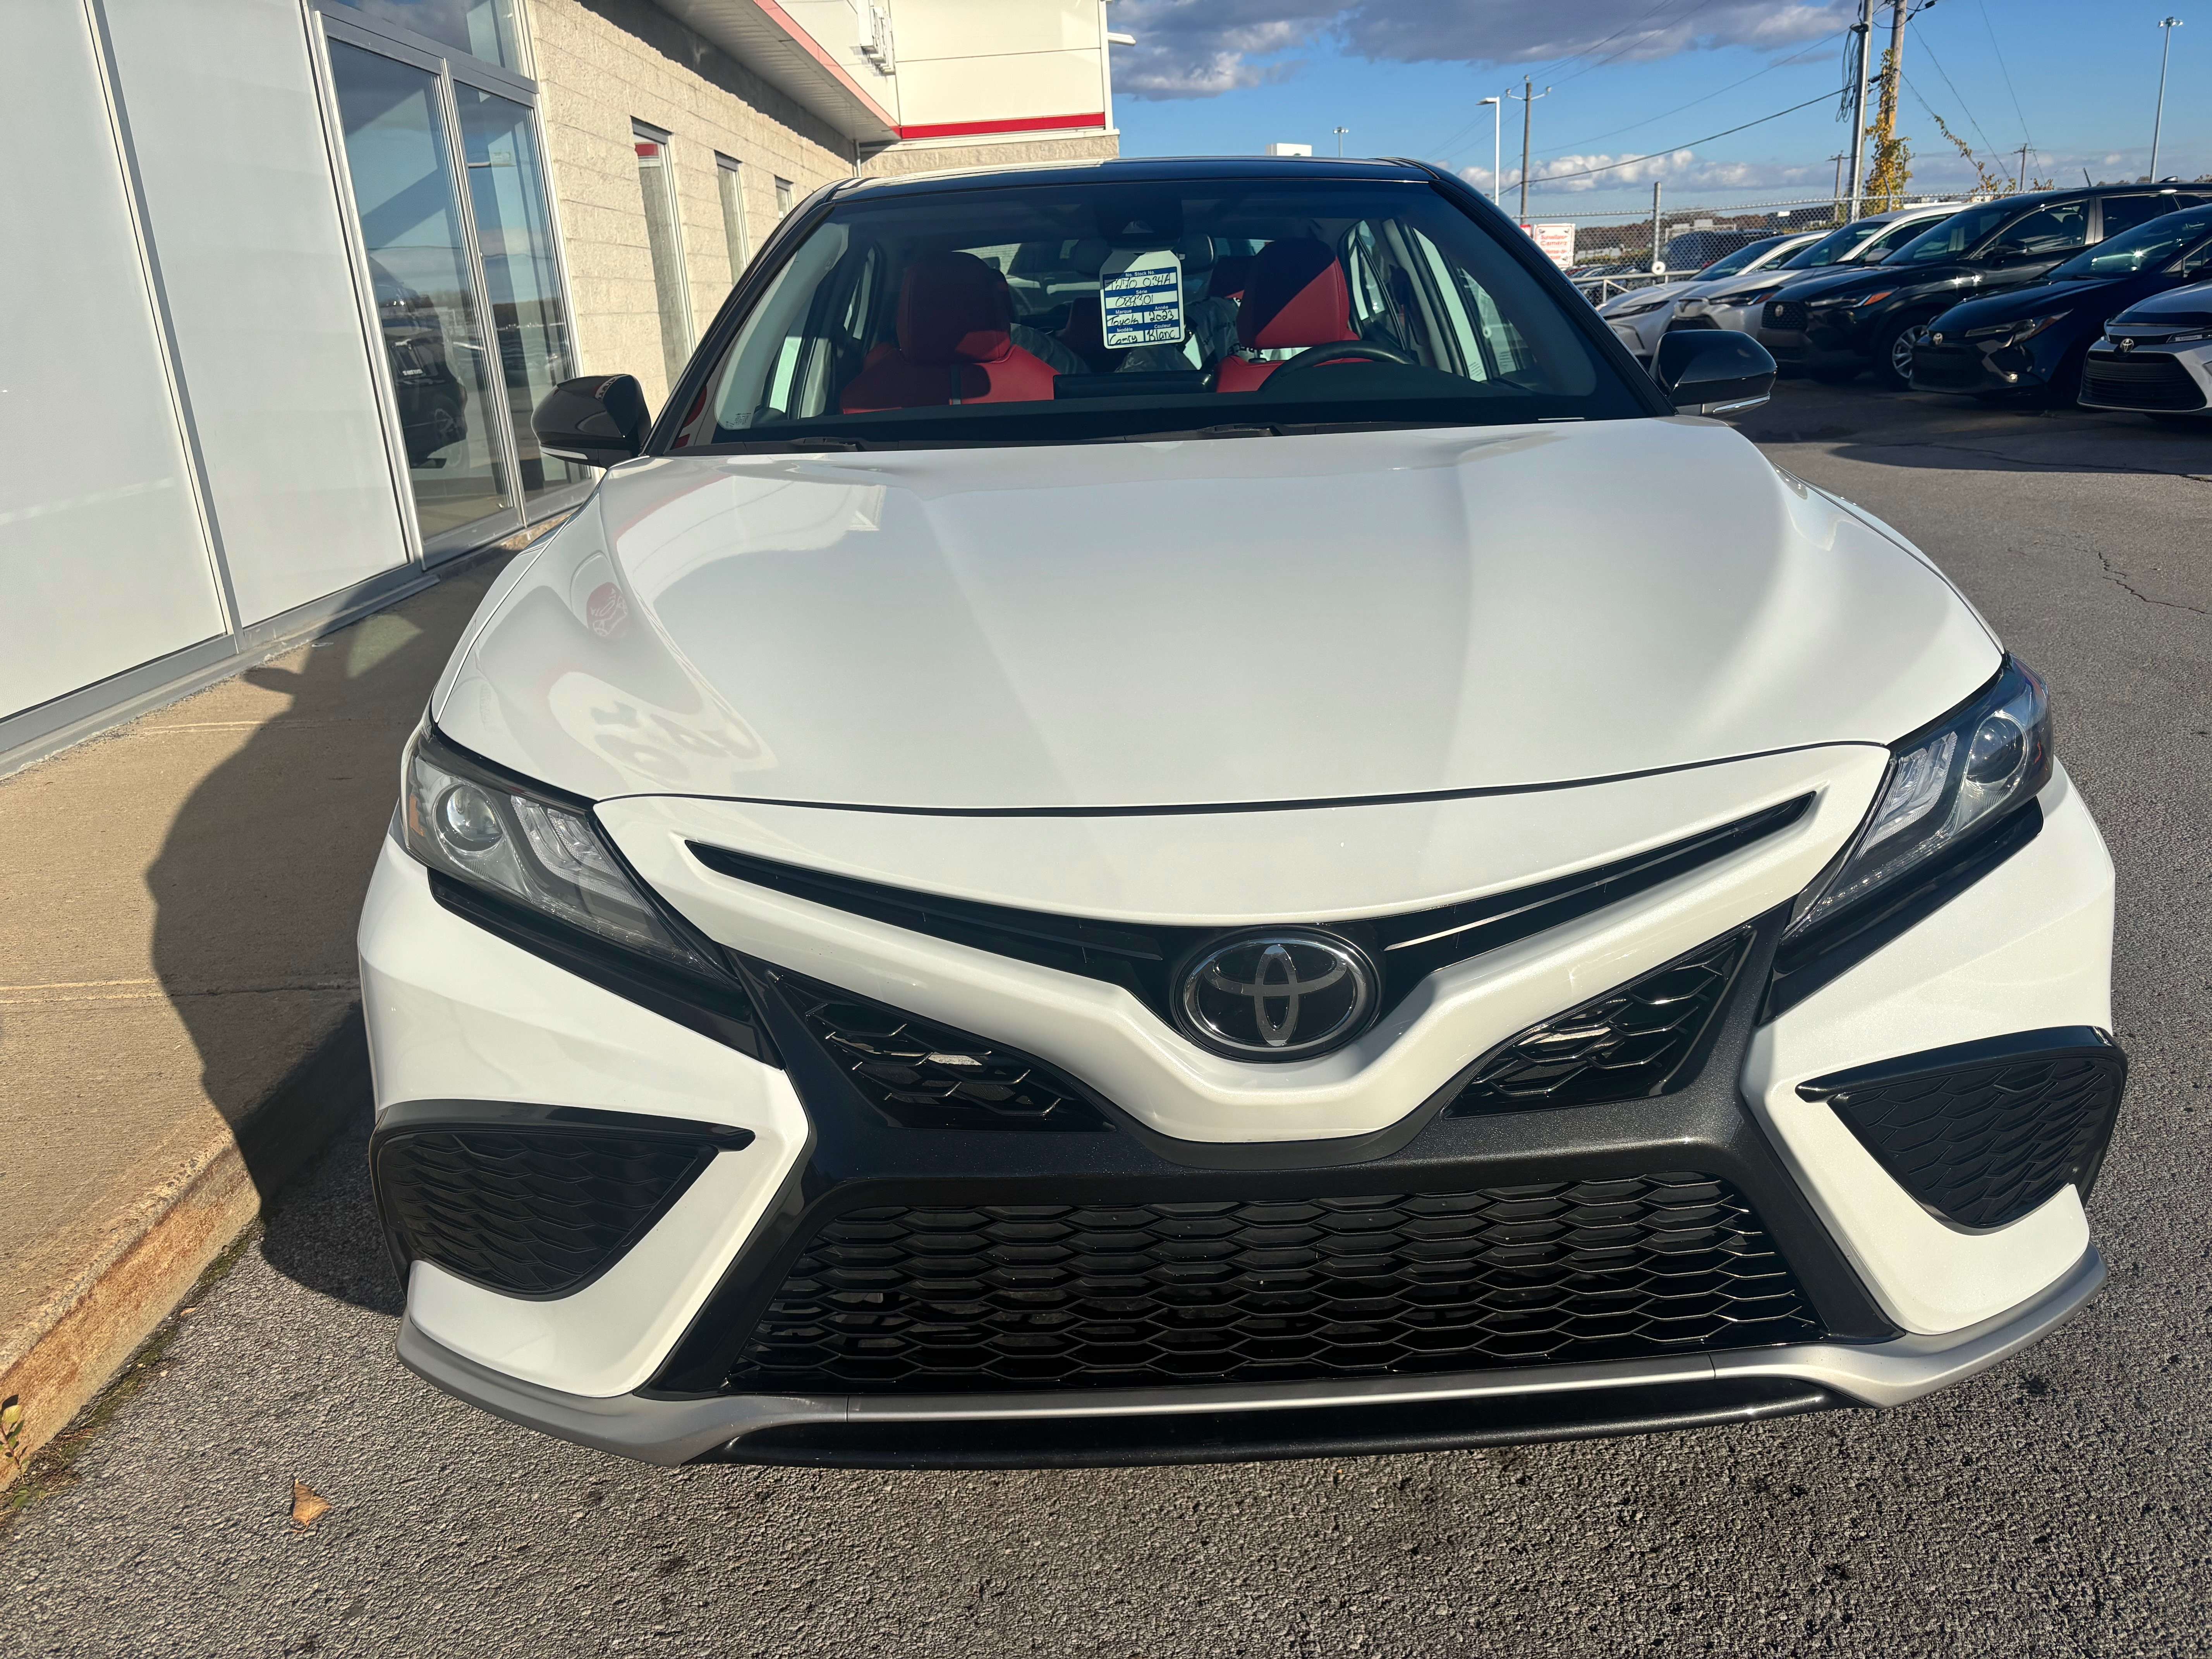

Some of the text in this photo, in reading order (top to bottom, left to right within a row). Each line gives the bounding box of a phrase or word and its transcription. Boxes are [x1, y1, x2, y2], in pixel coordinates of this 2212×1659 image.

[1149, 310, 1174, 321] 2023
[1109, 334, 1138, 344] Camry
[1147, 330, 1175, 341] Blanc
